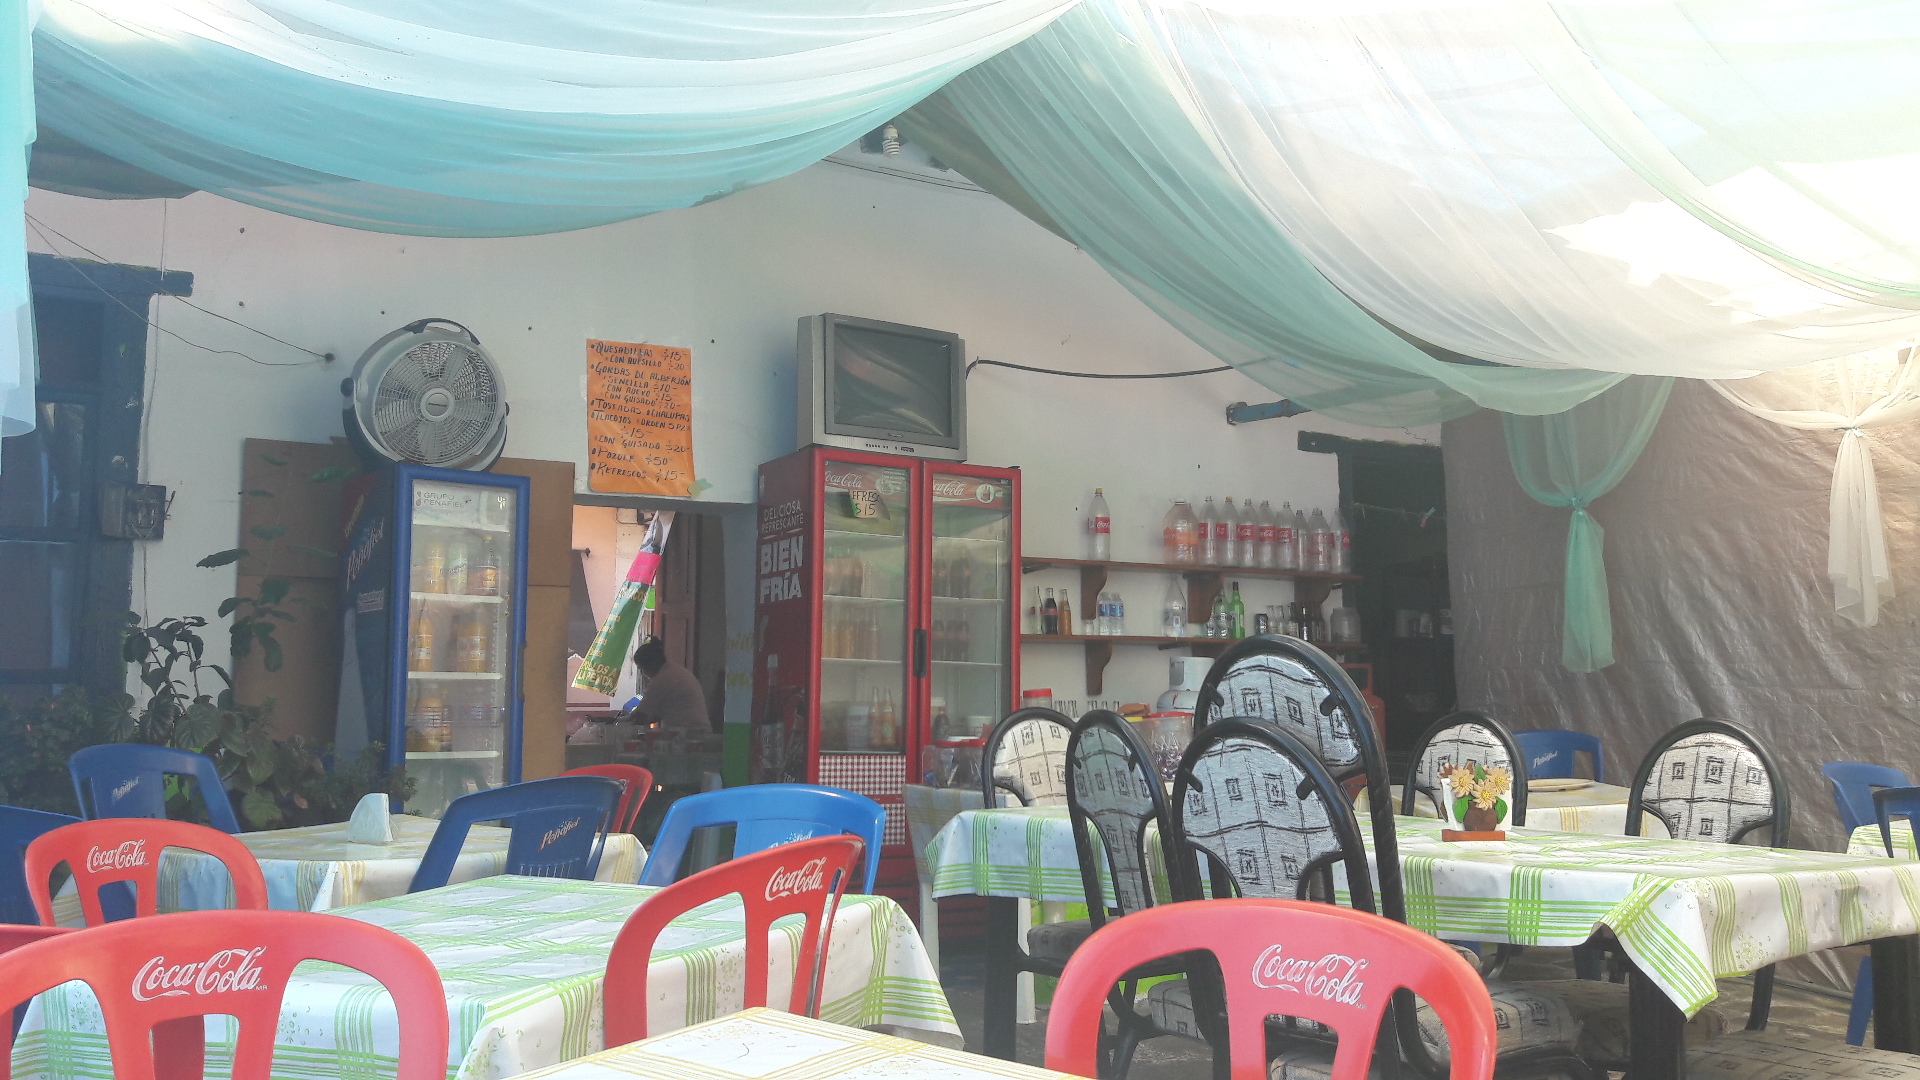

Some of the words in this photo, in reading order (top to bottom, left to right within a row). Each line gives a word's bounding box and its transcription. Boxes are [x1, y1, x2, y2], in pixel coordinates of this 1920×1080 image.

[595, 342, 653, 357] QUESADILLAS
[610, 355, 625, 363] CON
[595, 361, 630, 376] GORDAS
[635, 370, 645, 379] DE
[607, 376, 649, 389] SENCILLA
[607, 384, 622, 392] CON
[605, 391, 621, 400] CON
[623, 395, 656, 407] GUISADO
[595, 398, 642, 415] TOSTADAS
[652, 409, 690, 422] CHALUPAS
[640, 418, 666, 429] ORDEN
[599, 435, 616, 445] CON
[622, 439, 661, 449] GUISADO
[597, 462, 647, 479] REFRESCOS
[423, 492, 455, 500] GRUPO
[763, 500, 802, 521] DELICIOSA
[761, 513, 804, 533] REFRESCANTE
[760, 535, 804, 575] BIEN
[759, 571, 803, 604] FRÍA
[86, 839, 146, 873] Coca-Cola
[764, 856, 827, 902] Coca-Cola
[131, 945, 267, 1002] Coca-Cola
[1251, 943, 1371, 1006] Coca-Cola
